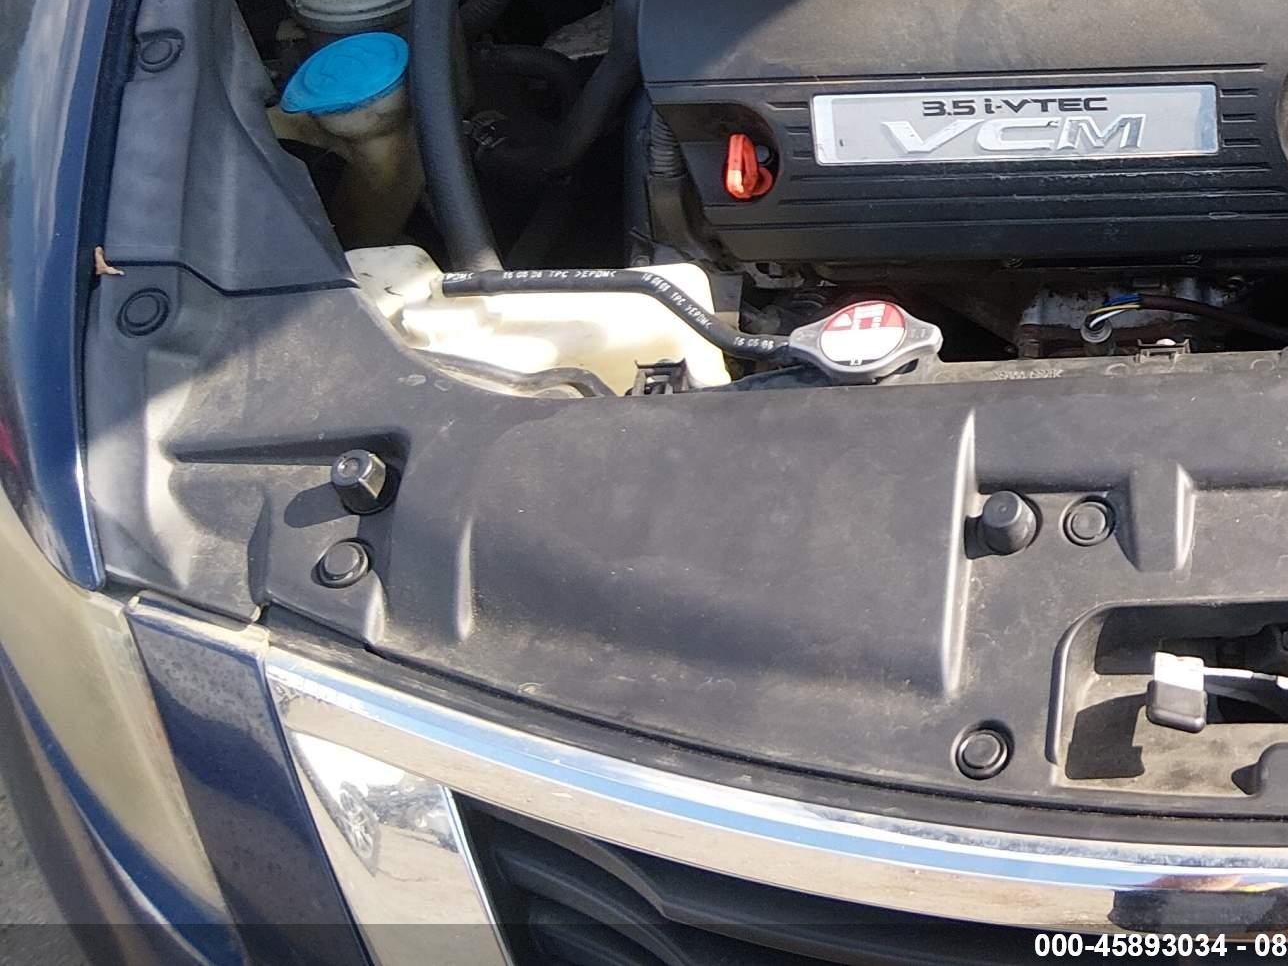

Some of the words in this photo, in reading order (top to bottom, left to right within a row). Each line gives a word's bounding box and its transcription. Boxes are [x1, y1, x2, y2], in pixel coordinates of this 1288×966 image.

[922, 97, 976, 116] 3.5
[984, 96, 1108, 114] i-VTEC
[881, 113, 1147, 155] VCM
